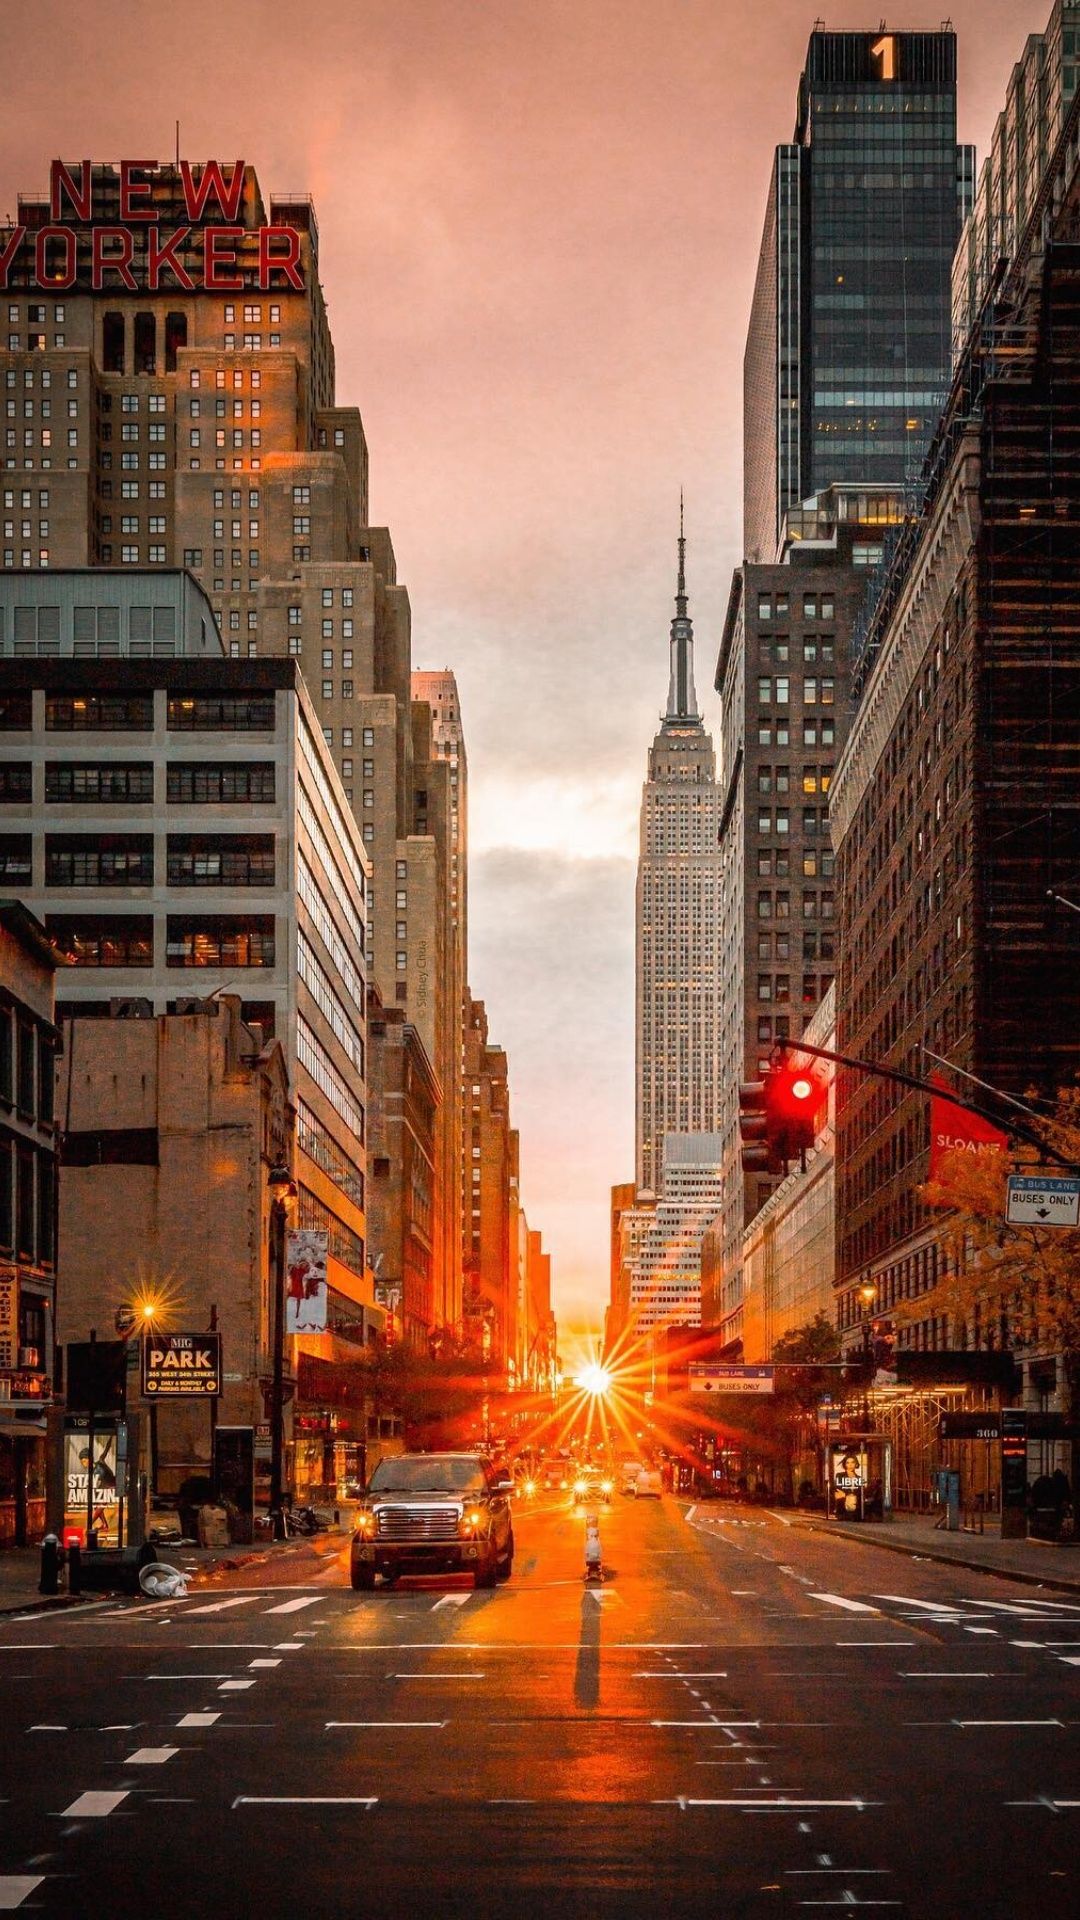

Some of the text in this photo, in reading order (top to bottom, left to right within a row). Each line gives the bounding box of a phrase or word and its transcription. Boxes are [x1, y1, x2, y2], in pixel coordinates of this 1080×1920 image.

[871, 36, 894, 79] 1
[51, 159, 246, 222] NEW
[0, 226, 306, 290] YORKER
[1027, 1180, 1076, 1191] BUS LANE
[1012, 1193, 1075, 1206] BUSES ONLY
[150, 1350, 212, 1368] PARK
[836, 1477, 865, 1486] LIBRE
